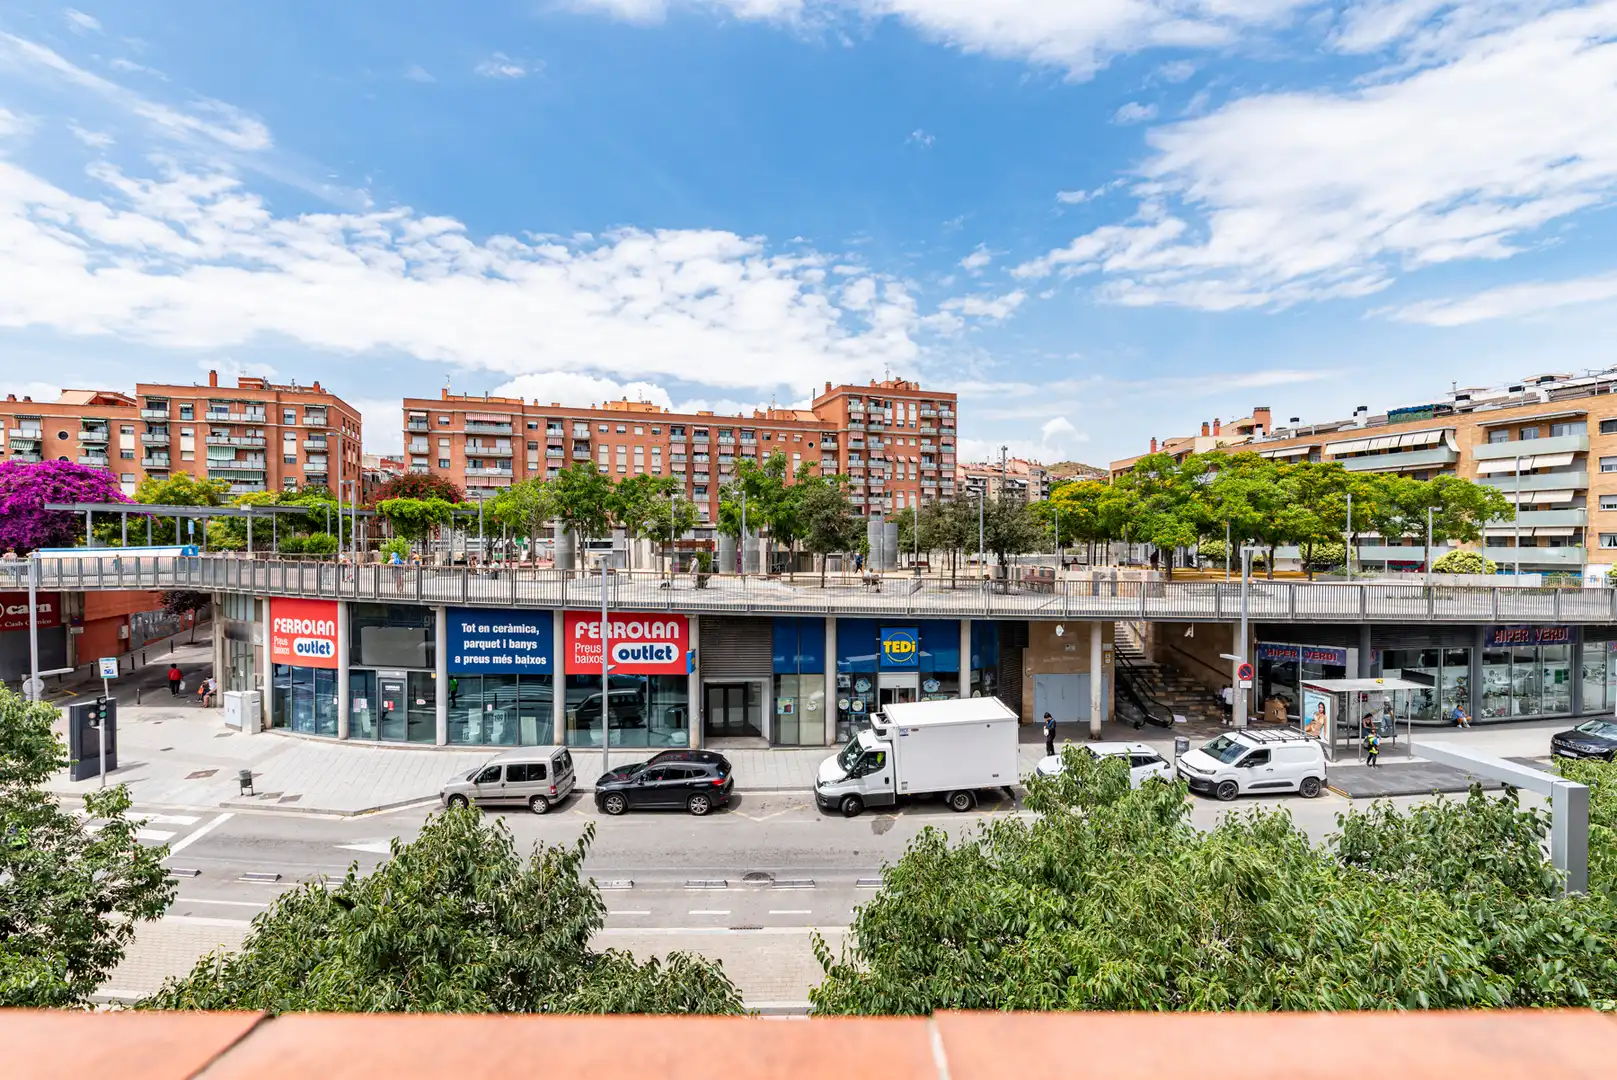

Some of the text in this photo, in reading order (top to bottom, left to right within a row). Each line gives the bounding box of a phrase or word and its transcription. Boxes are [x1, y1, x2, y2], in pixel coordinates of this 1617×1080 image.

[6, 603, 52, 615] can
[274, 617, 335, 636] FERROLAN
[461, 623, 540, 636] Tot en ceràmica,
[575, 621, 680, 639] FERROLAN
[1494, 627, 1569, 643] HIPER VERDI
[297, 640, 331, 655] outlet
[463, 639, 538, 651] parquet i banys
[574, 642, 602, 654] Preus
[883, 640, 916, 653] TEDi
[618, 645, 672, 660] outlet
[1267, 648, 1337, 661] HIPER VERDI
[454, 654, 547, 666] a preus més baixos
